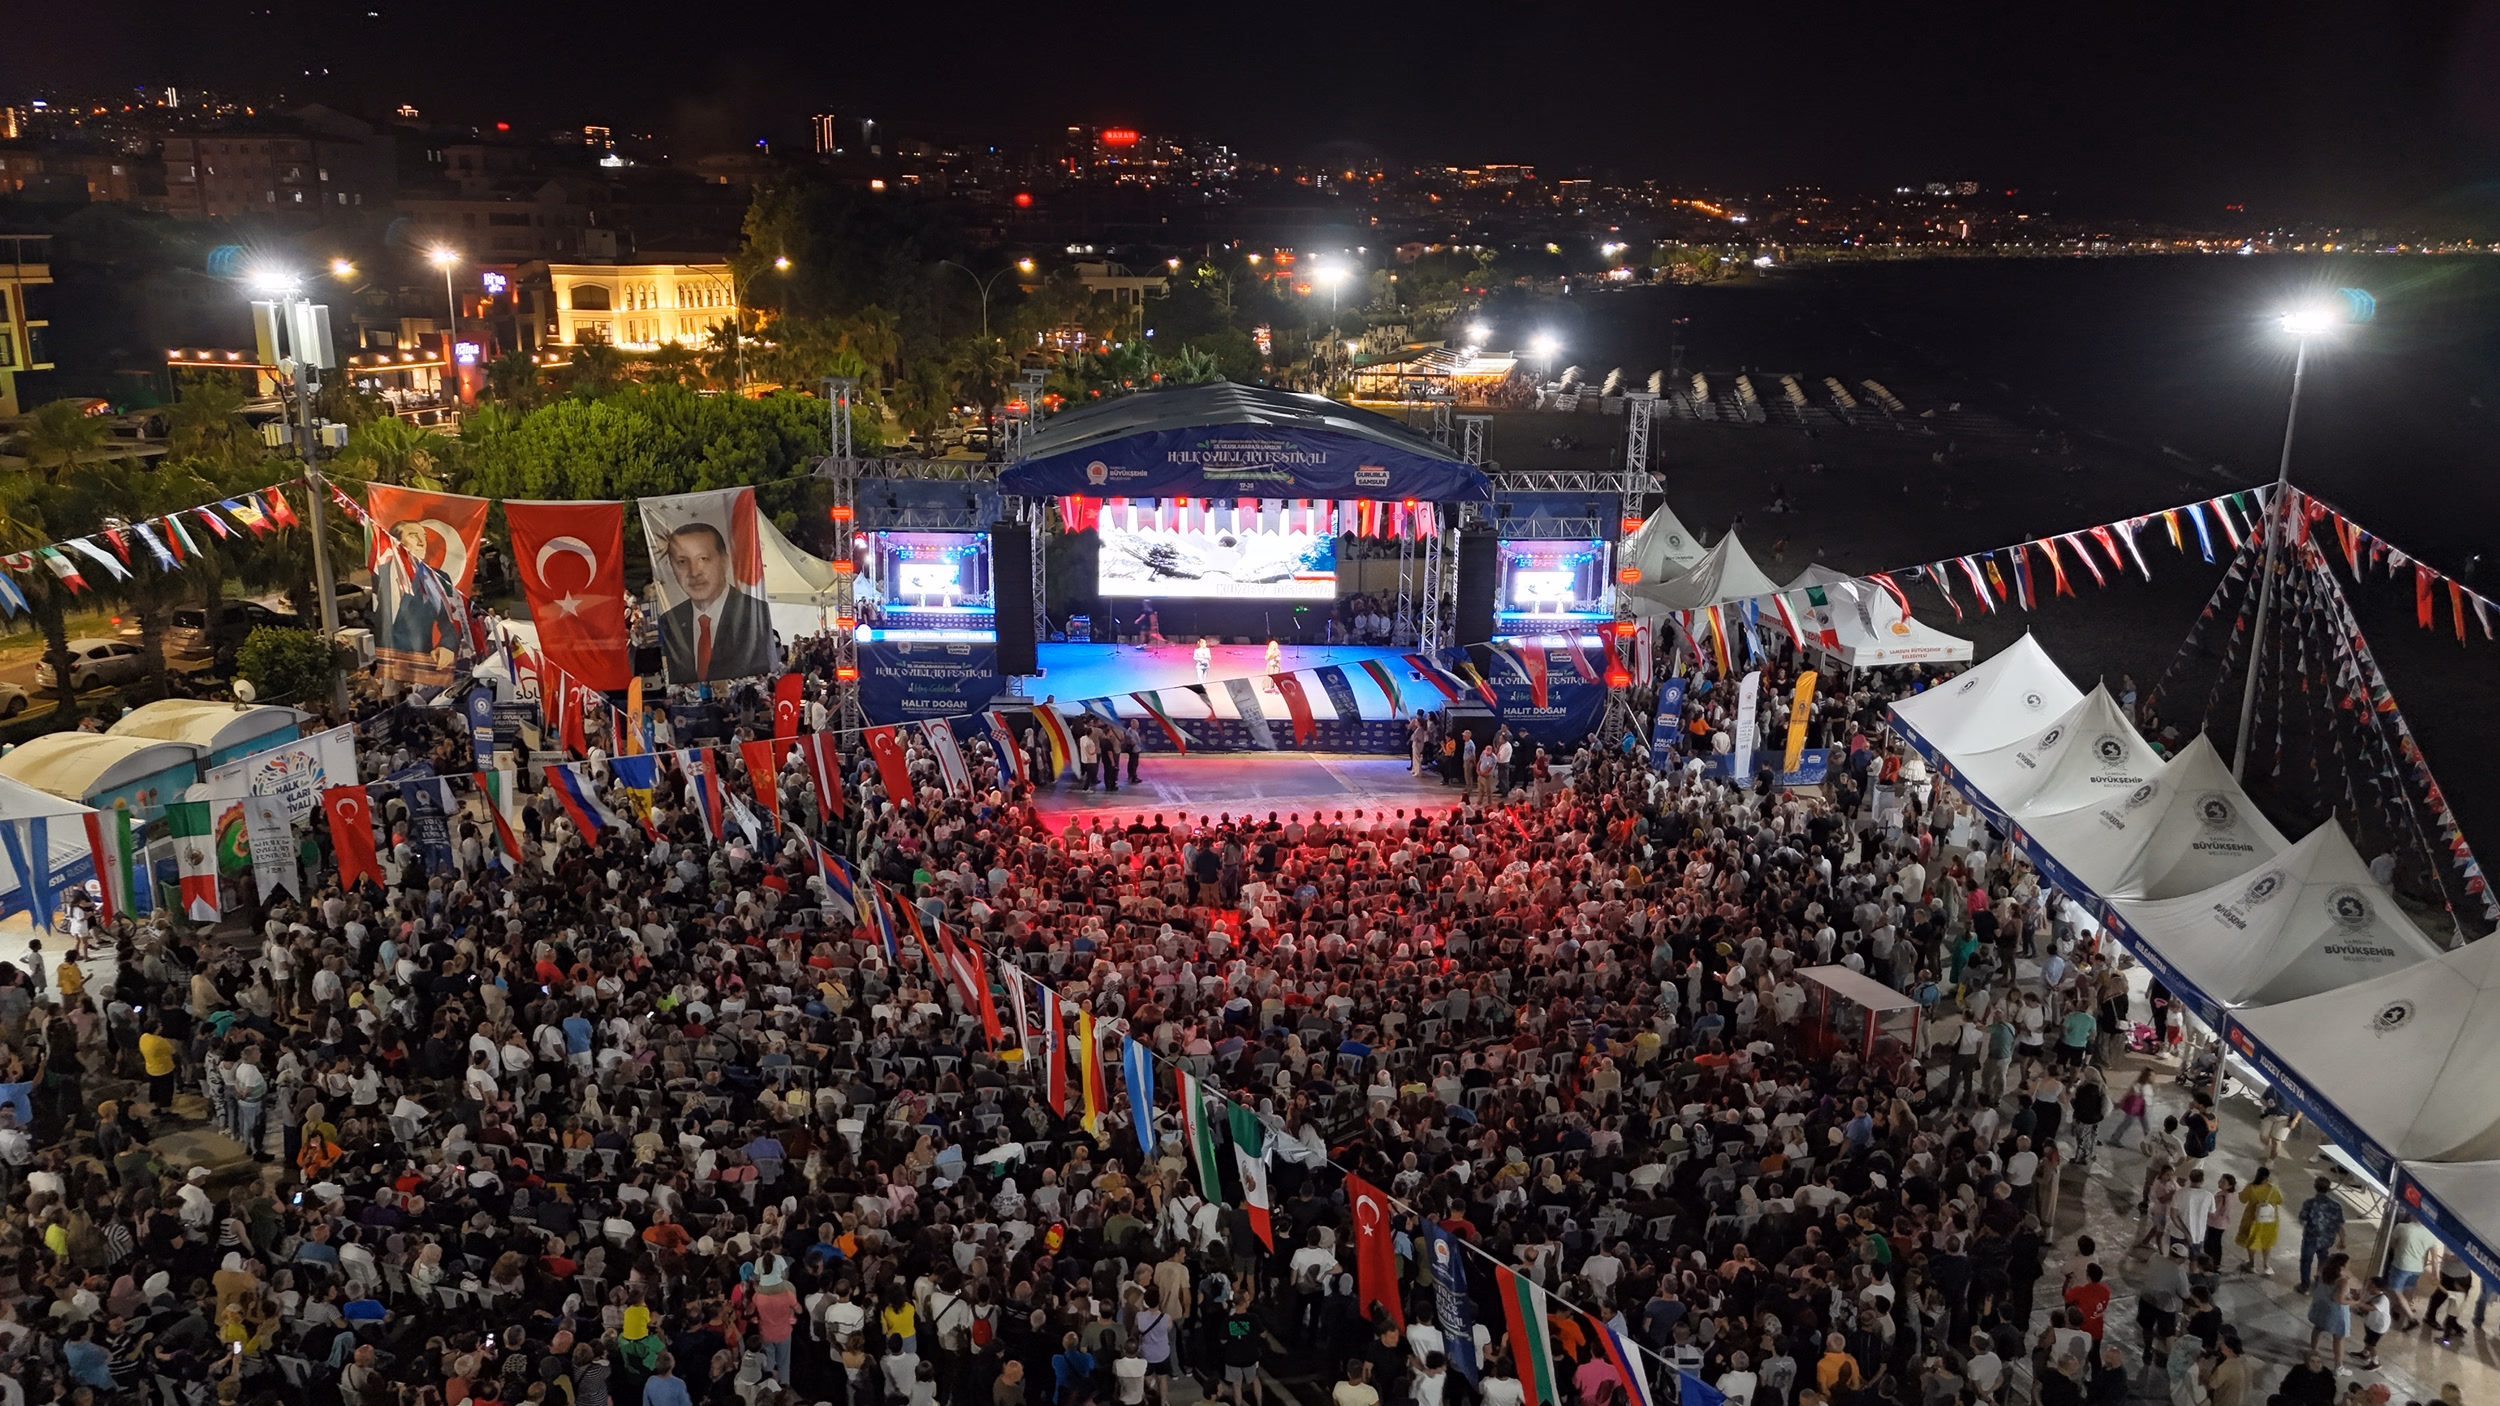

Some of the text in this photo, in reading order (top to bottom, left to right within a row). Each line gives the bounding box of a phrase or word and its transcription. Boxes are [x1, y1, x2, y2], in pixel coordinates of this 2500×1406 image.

[1167, 451, 1201, 464] HALK
[1202, 451, 1262, 464] OYUNLARI
[1216, 584, 1333, 597] KUZEY OSETYA
[276, 780, 299, 794] HALK
[2192, 842, 2254, 852] BÜYÜKŞEHİR
[2324, 944, 2395, 957] BÜYÜKŞEHİR
[2260, 1054, 2281, 1079] KUZEY
[2280, 1072, 2305, 1101] OSETYA
